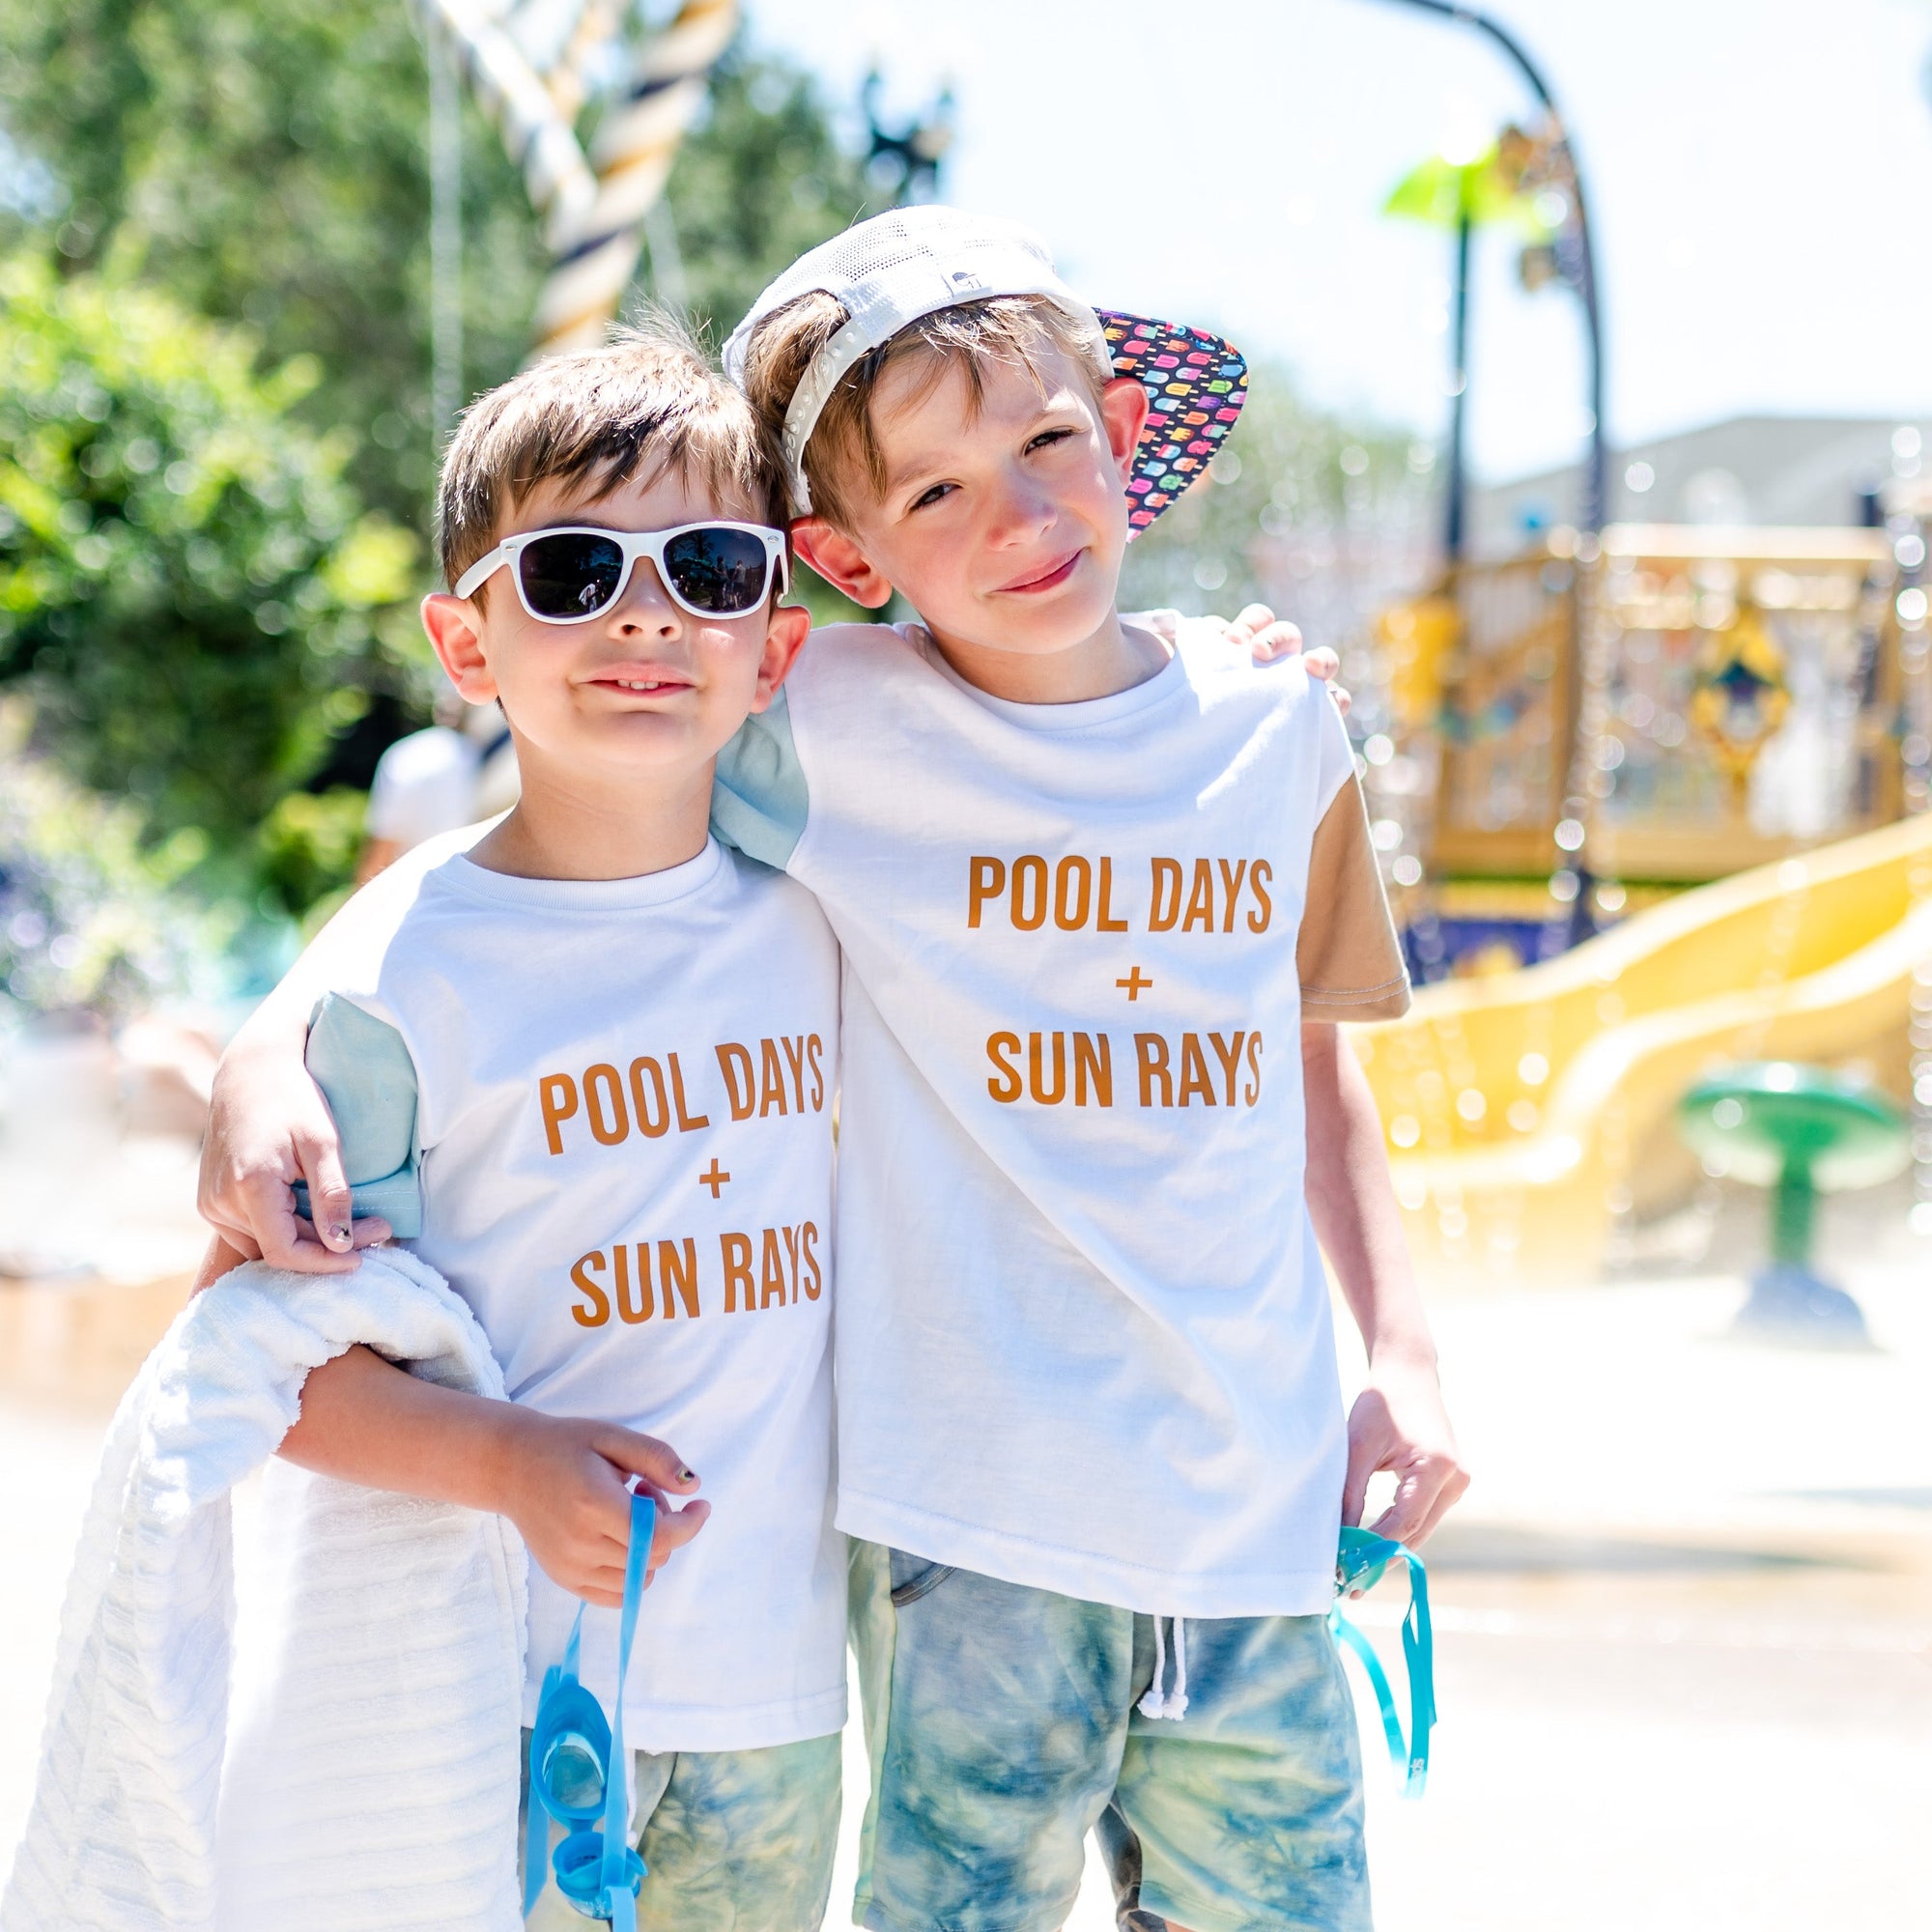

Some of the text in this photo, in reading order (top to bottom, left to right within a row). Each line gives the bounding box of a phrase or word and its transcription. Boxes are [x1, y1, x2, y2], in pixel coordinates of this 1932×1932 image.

[968, 855, 1272, 933] POOL DAYS
[1116, 967, 1152, 1001] +
[540, 1034, 823, 1155] POOL DAYS
[986, 1032, 1263, 1107] SUN RAYS
[699, 1158, 730, 1198] +
[571, 1221, 821, 1327] SUN RAYS
